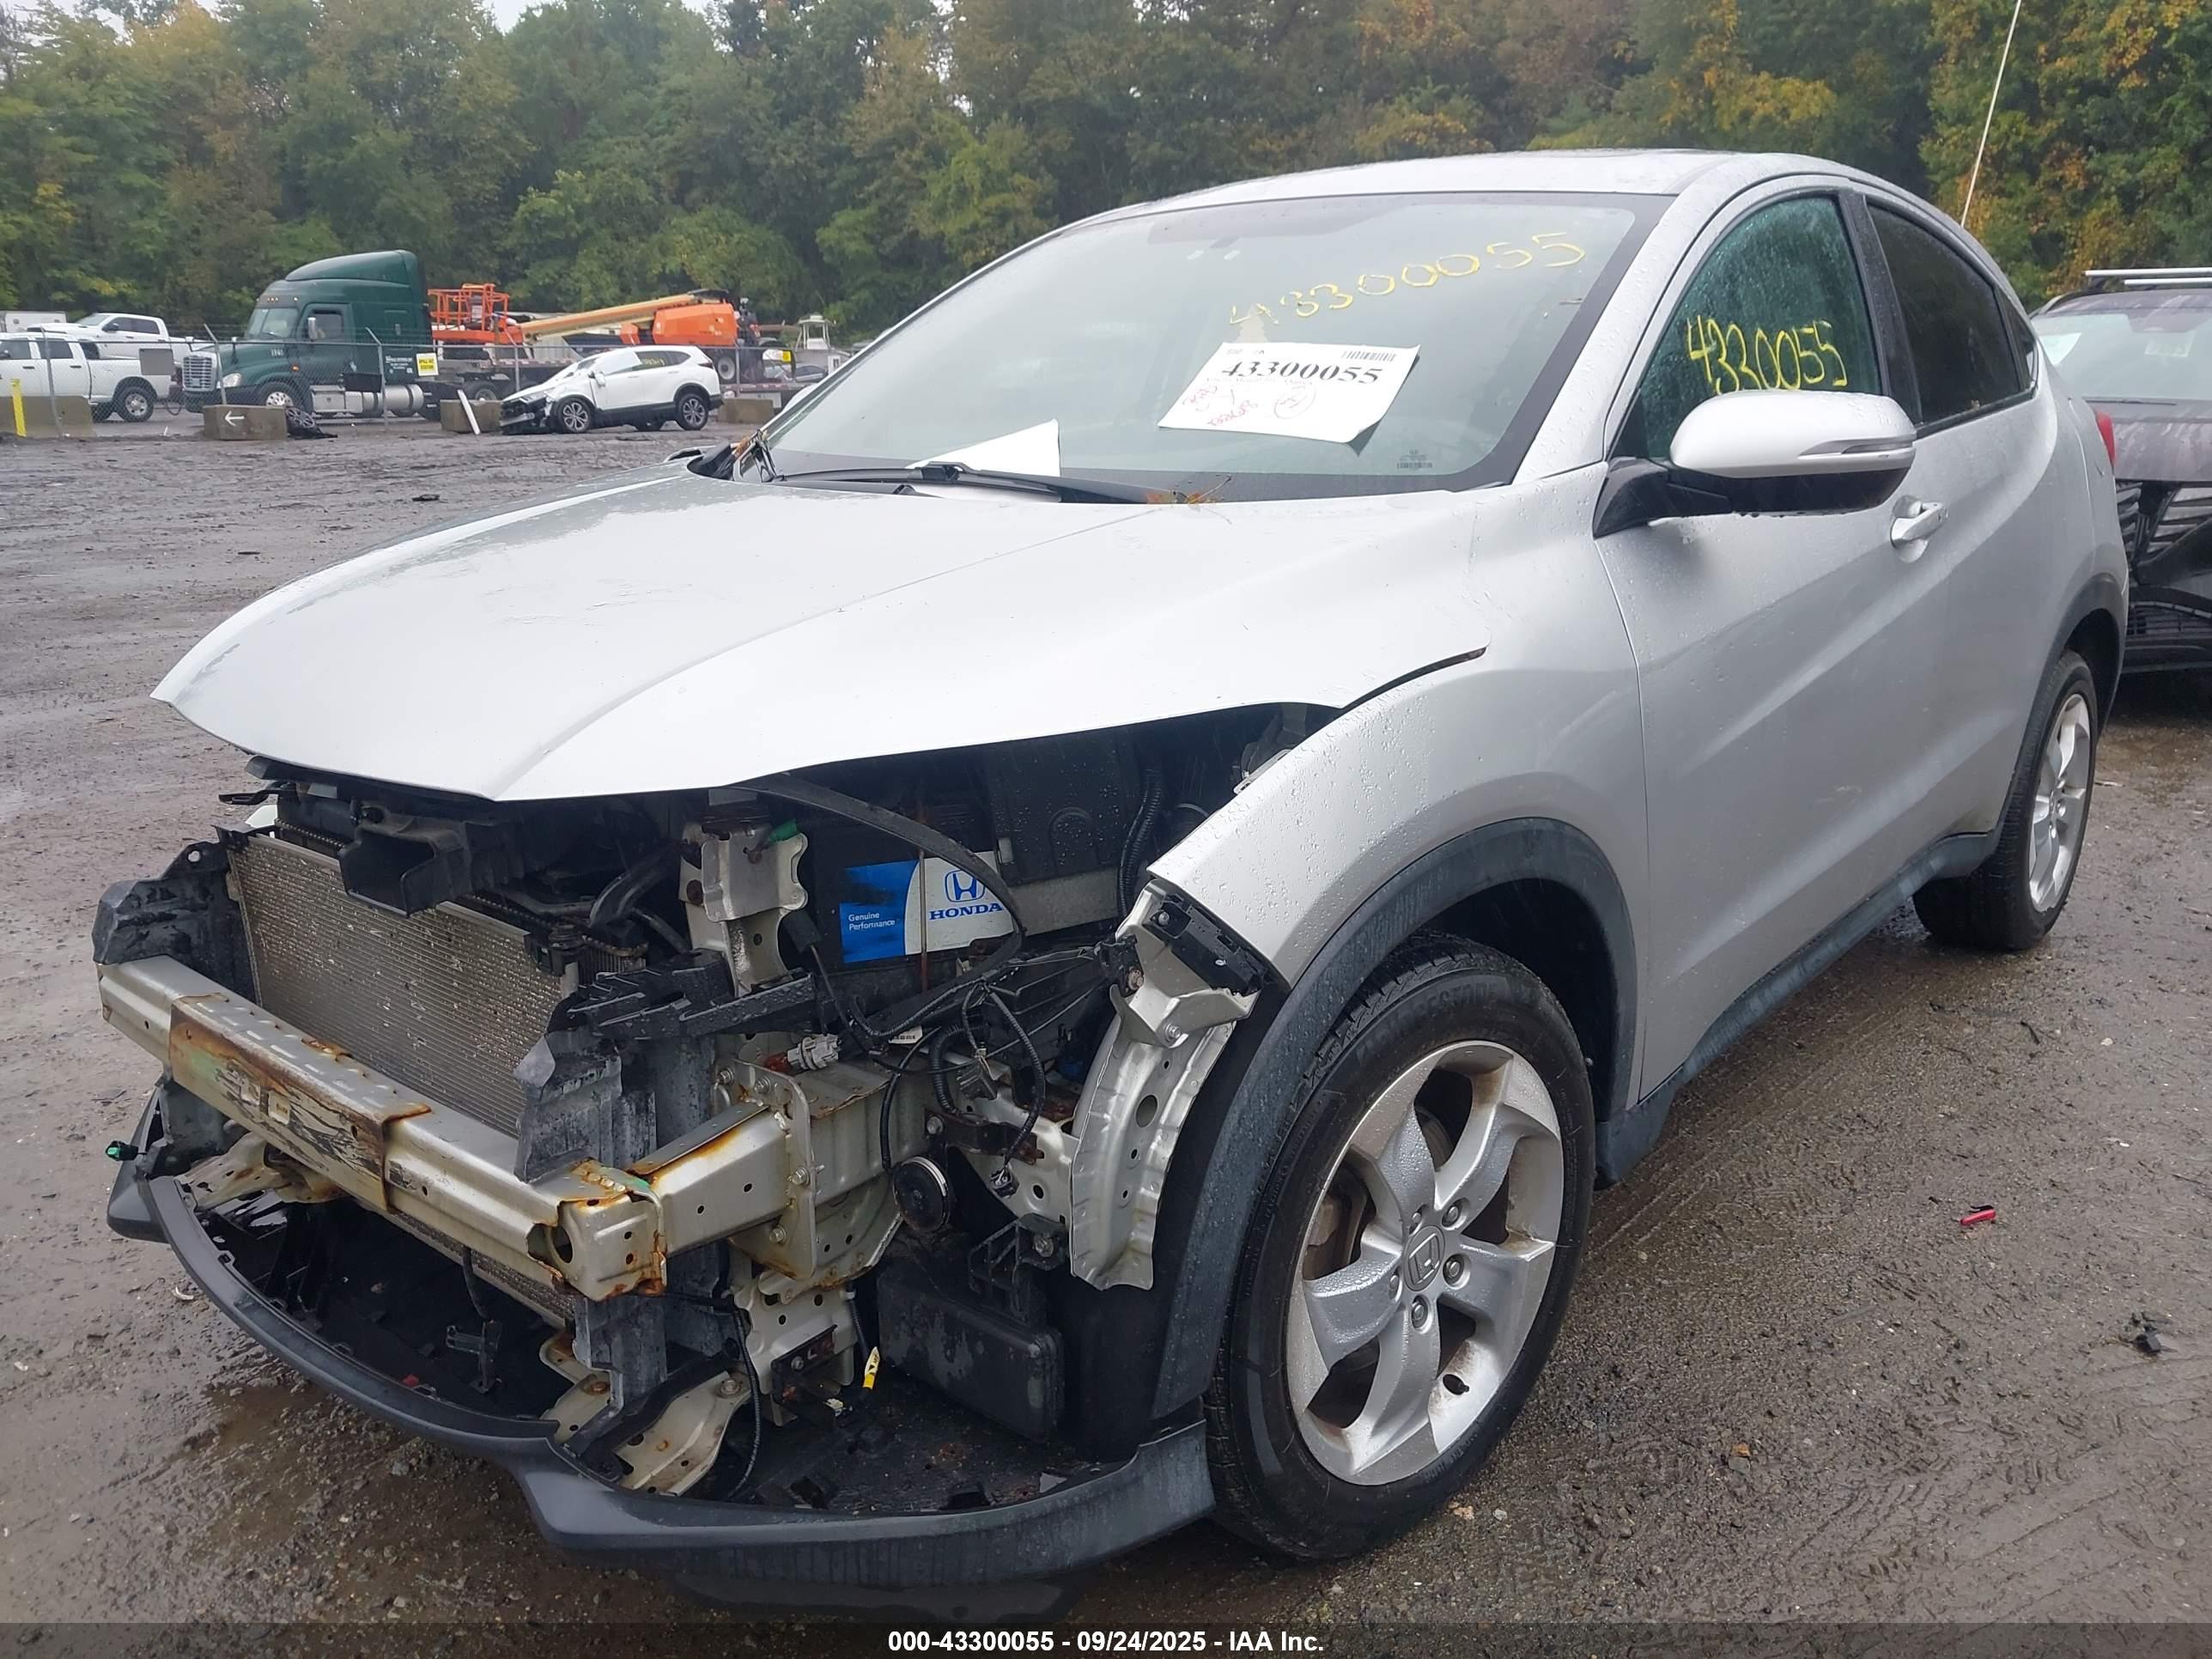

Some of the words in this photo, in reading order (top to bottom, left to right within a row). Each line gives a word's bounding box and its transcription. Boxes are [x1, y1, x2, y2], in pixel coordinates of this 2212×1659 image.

[1229, 231, 1587, 325] 43300055
[1221, 361, 1383, 385] 43300055
[848, 912, 880, 922] Genuine
[928, 902, 1003, 921] HONDA
[848, 919, 896, 932] Performance
